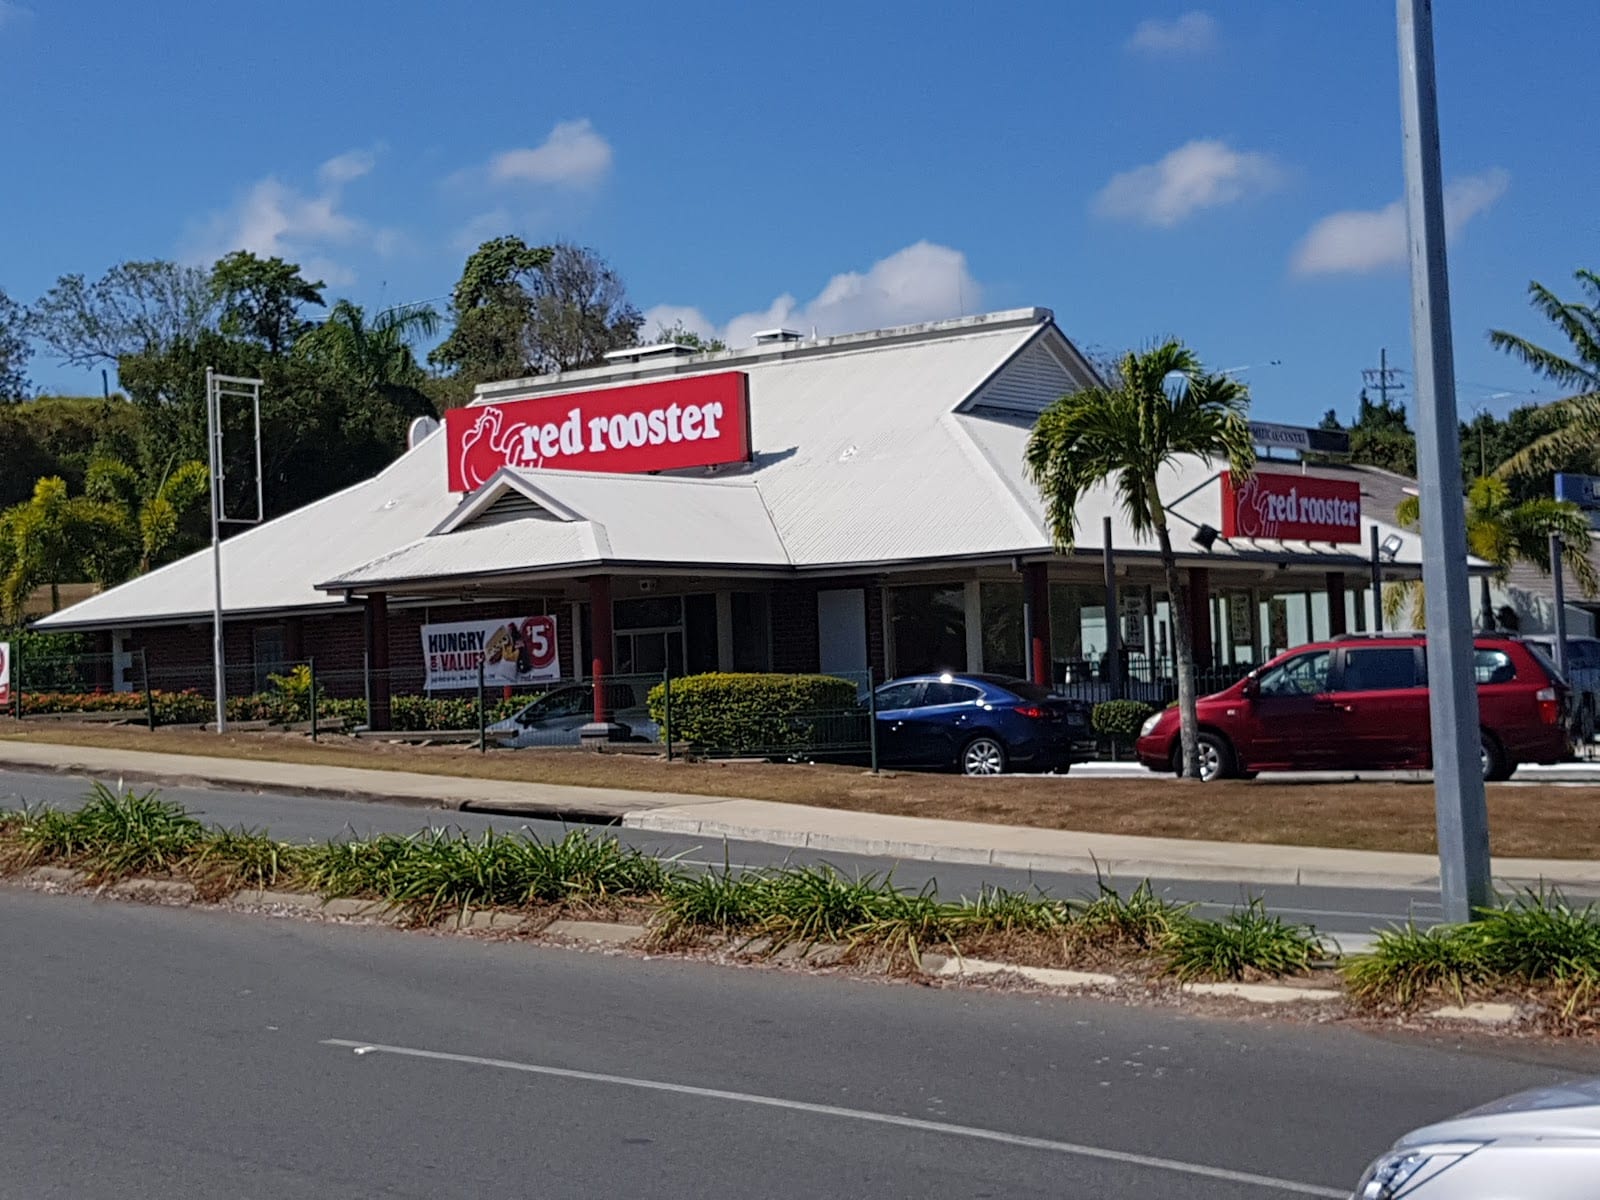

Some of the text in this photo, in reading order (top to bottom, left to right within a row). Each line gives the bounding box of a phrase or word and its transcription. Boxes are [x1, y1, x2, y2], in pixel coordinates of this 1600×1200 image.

[521, 401, 723, 461] red rooster
[1267, 487, 1358, 527] red rooster
[428, 631, 486, 653] HUNGRY
